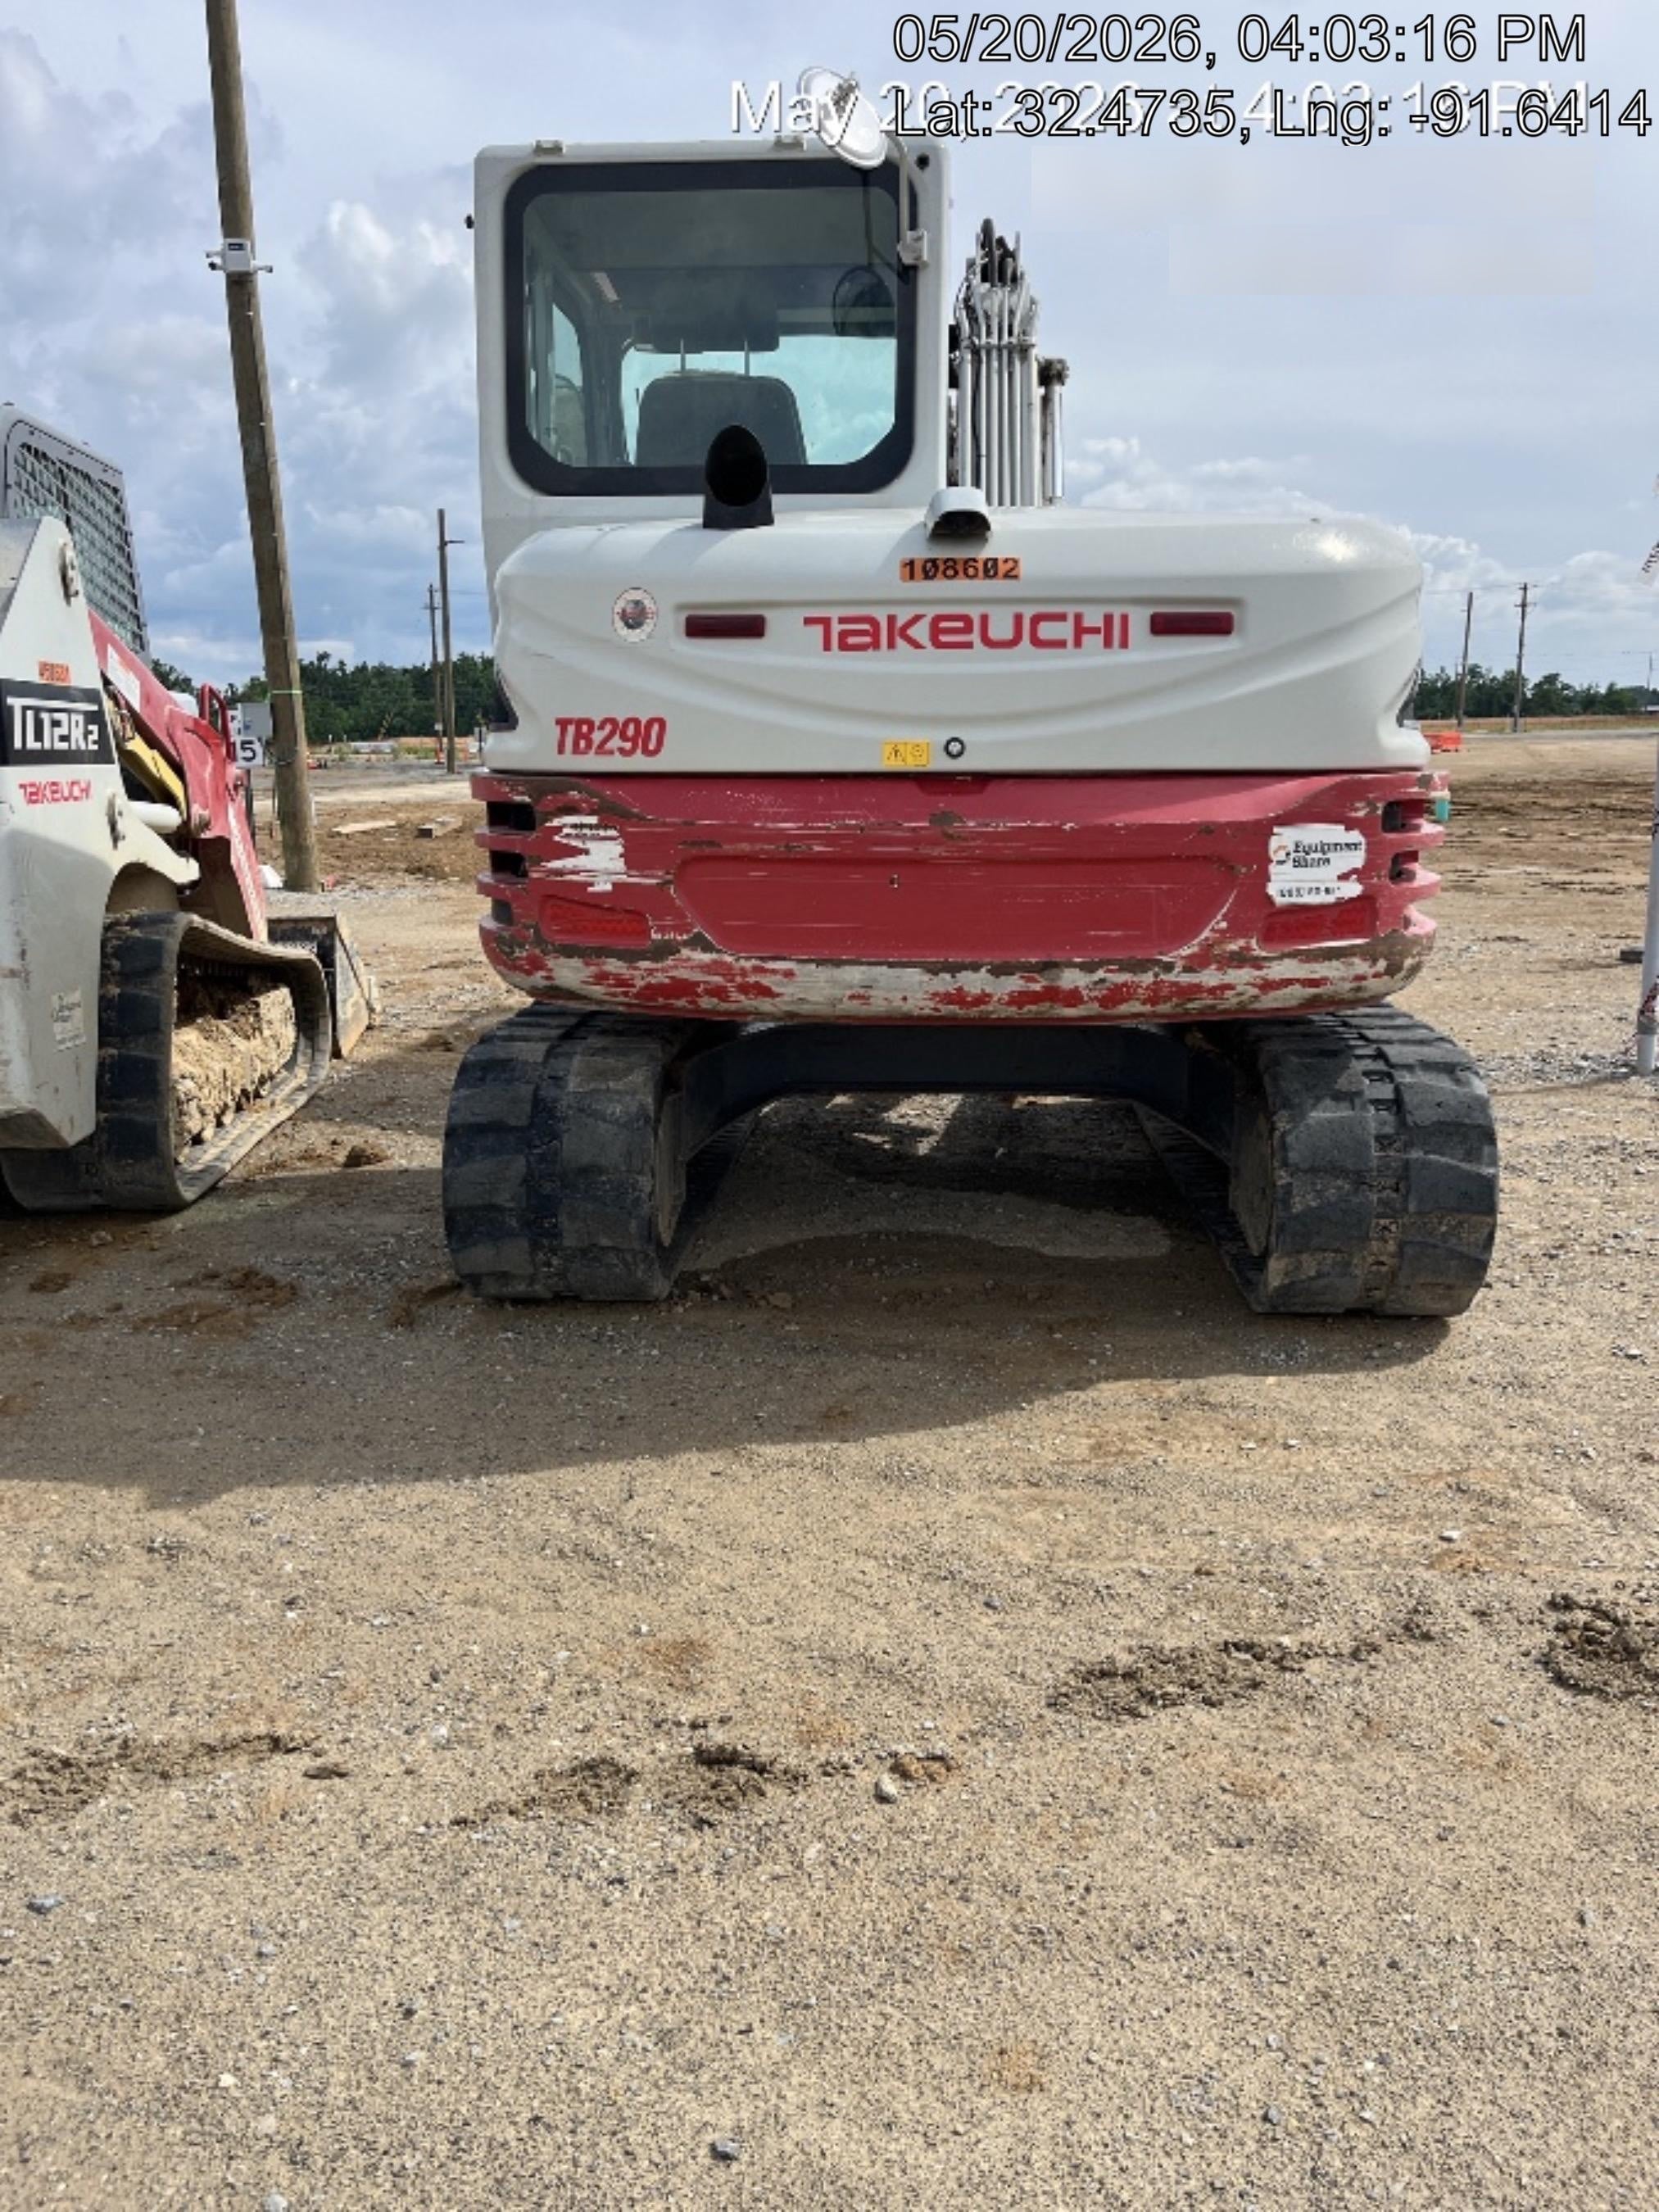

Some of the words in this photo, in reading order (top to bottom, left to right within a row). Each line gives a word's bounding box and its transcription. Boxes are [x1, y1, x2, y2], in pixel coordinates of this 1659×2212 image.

[903, 556, 1020, 581] 108602
[803, 611, 1129, 652] TAKEUCHI
[555, 716, 667, 758] TB290
